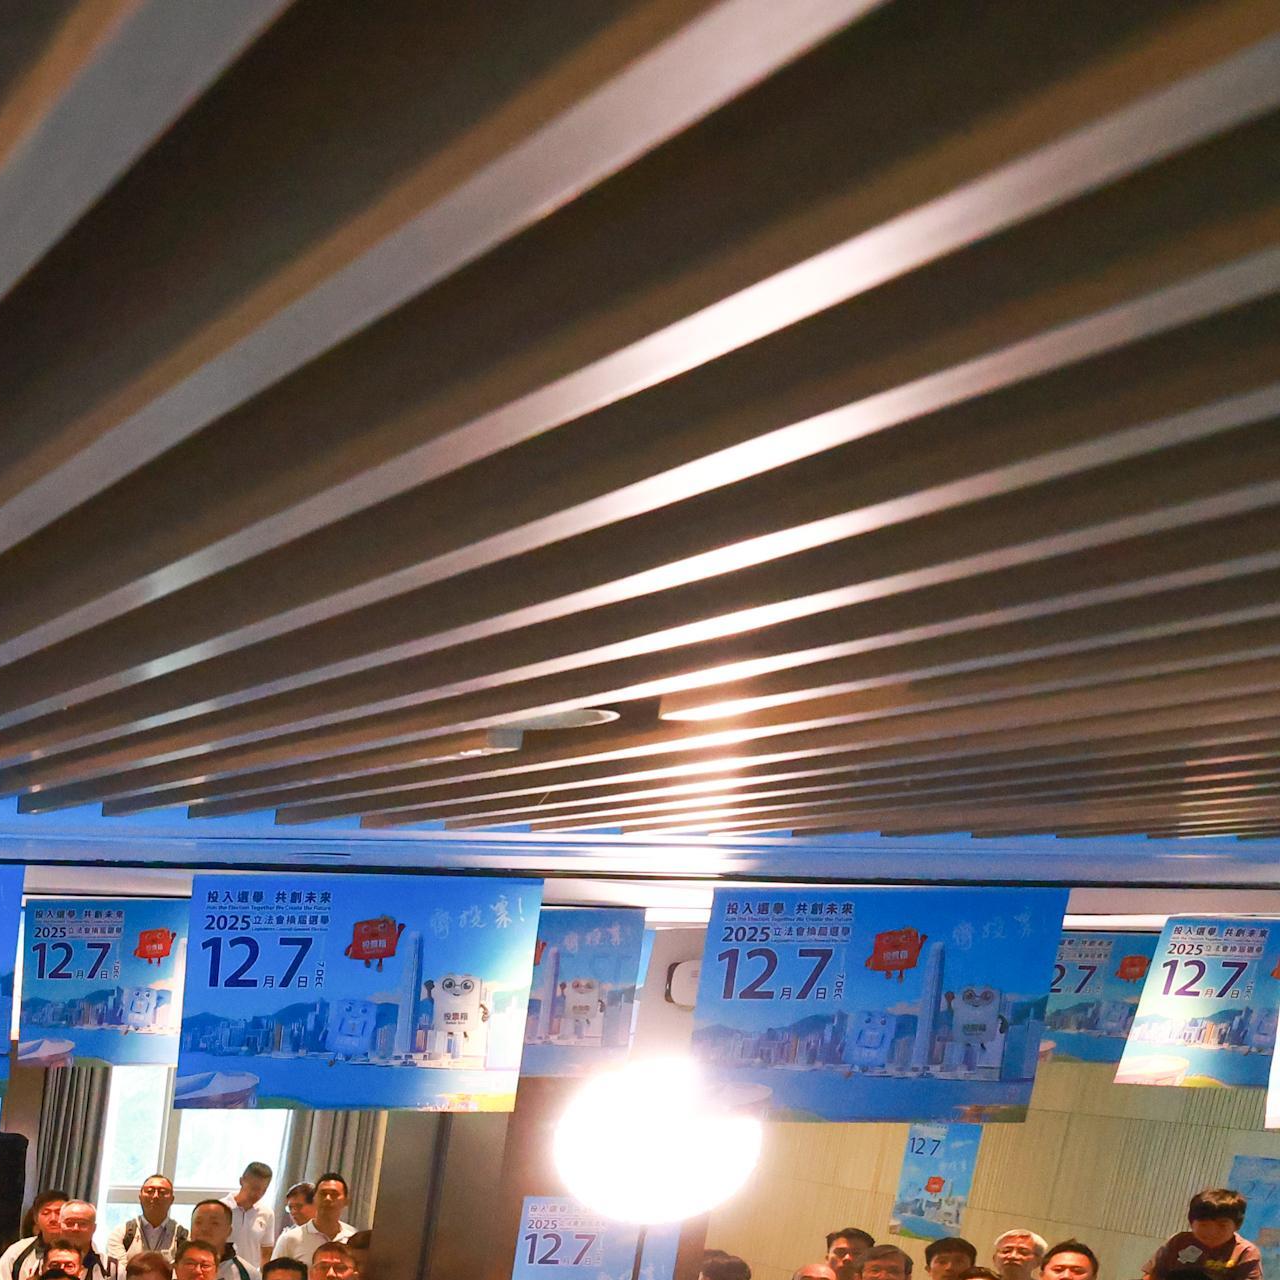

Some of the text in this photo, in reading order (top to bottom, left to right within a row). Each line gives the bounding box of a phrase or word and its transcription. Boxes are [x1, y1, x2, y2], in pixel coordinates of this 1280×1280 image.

[208, 891, 331, 903] 投入選舉 共創未來
[727, 902, 853, 914] 投入選舉 共創未來
[205, 915, 251, 930] 2025
[35, 927, 66, 938] 2025
[722, 926, 770, 942] 2025
[1168, 943, 1203, 955] 2025
[32, 942, 111, 979] 12月7日
[202, 937, 313, 988] 12月7日
[718, 948, 833, 1000] 12月7日
[1162, 959, 1248, 999] 12月7日
[528, 1219, 557, 1230] 2025
